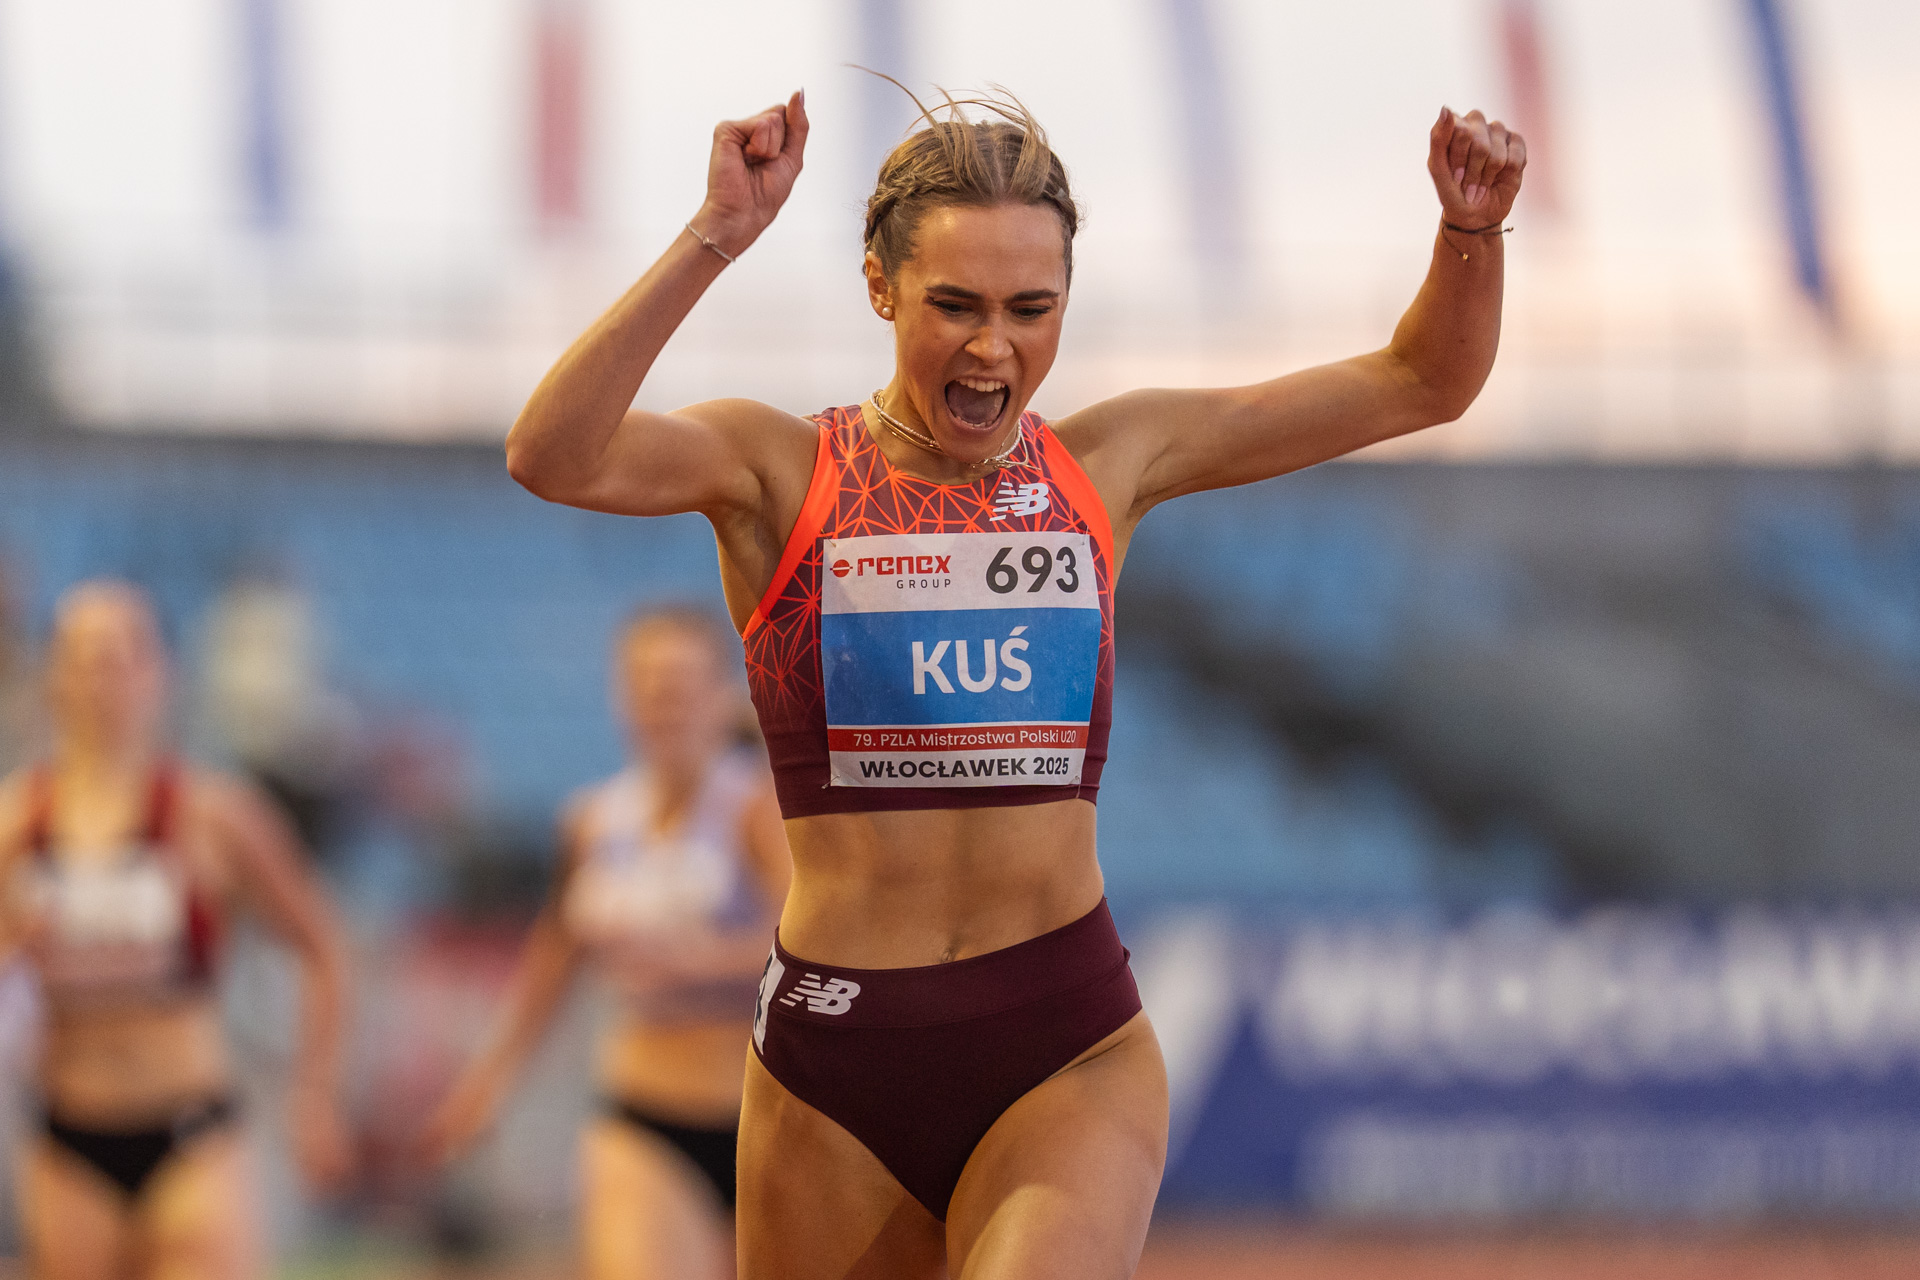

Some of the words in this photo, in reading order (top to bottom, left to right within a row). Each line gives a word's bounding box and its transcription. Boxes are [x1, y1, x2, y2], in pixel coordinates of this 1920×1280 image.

[857, 555, 952, 576] renex
[986, 546, 1079, 593] 693
[896, 579, 951, 589] GROUP
[911, 625, 1032, 695] KUŚ
[853, 734, 876, 747] 79.
[880, 734, 916, 747] PZLA
[921, 731, 1015, 747] Mistrzostwa
[1019, 729, 1059, 744] Polski
[1060, 730, 1077, 743] U20
[859, 758, 1027, 778] WŁOCŁAWEK
[1032, 756, 1070, 775] 2025
